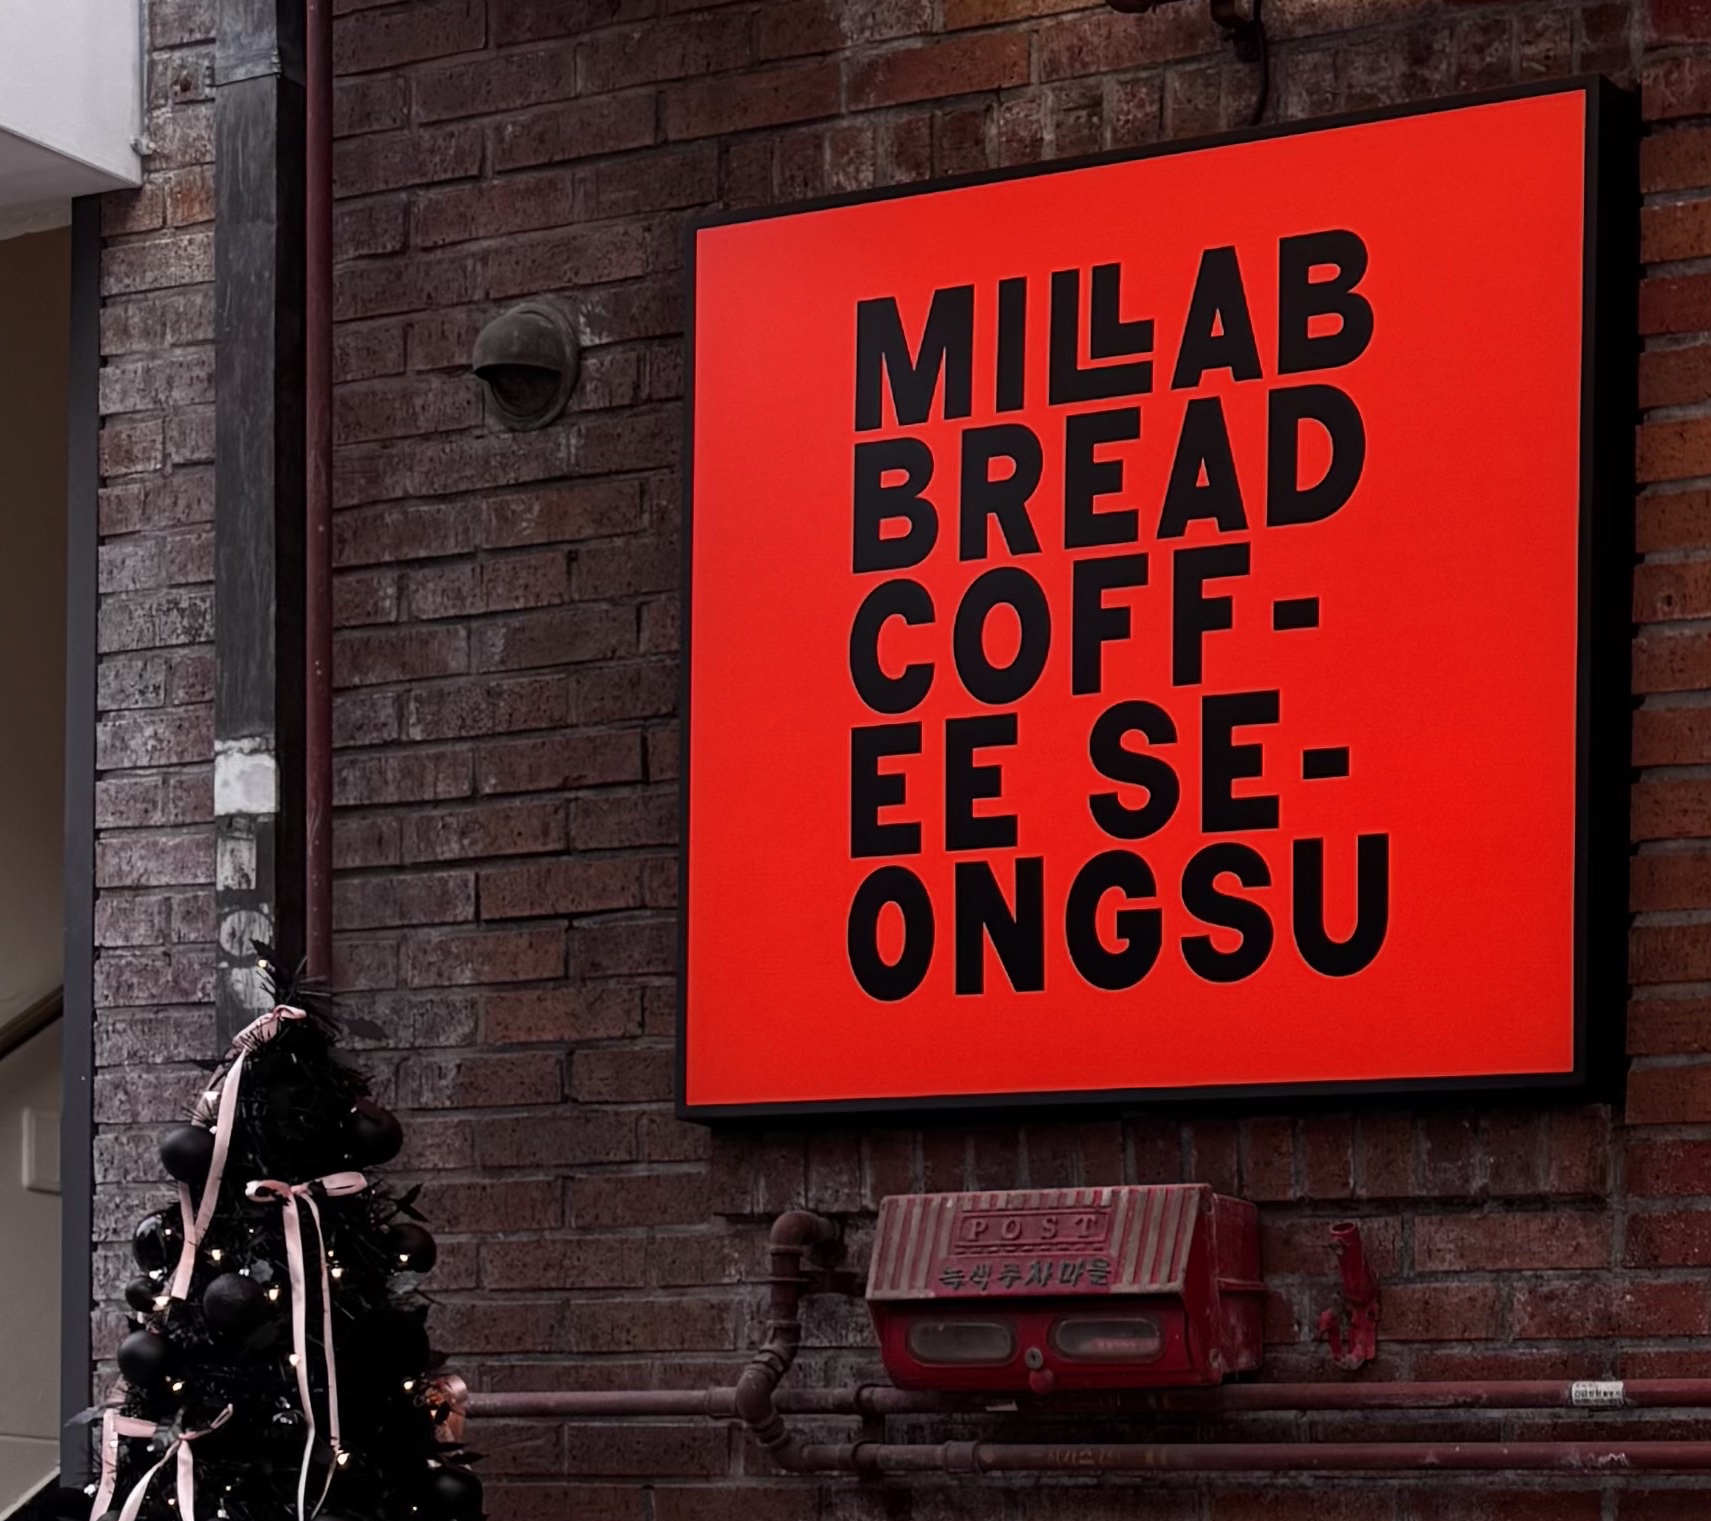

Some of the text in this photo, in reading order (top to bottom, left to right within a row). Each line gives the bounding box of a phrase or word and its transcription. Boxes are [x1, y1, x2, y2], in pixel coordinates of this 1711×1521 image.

[855, 229, 1374, 432] MILLAB
[852, 384, 1366, 574] BREAD
[849, 542, 1319, 715] COFF-
[850, 690, 1349, 859] EE SE-
[847, 833, 1389, 1002] ONGSU
[968, 1216, 1096, 1242] POST
